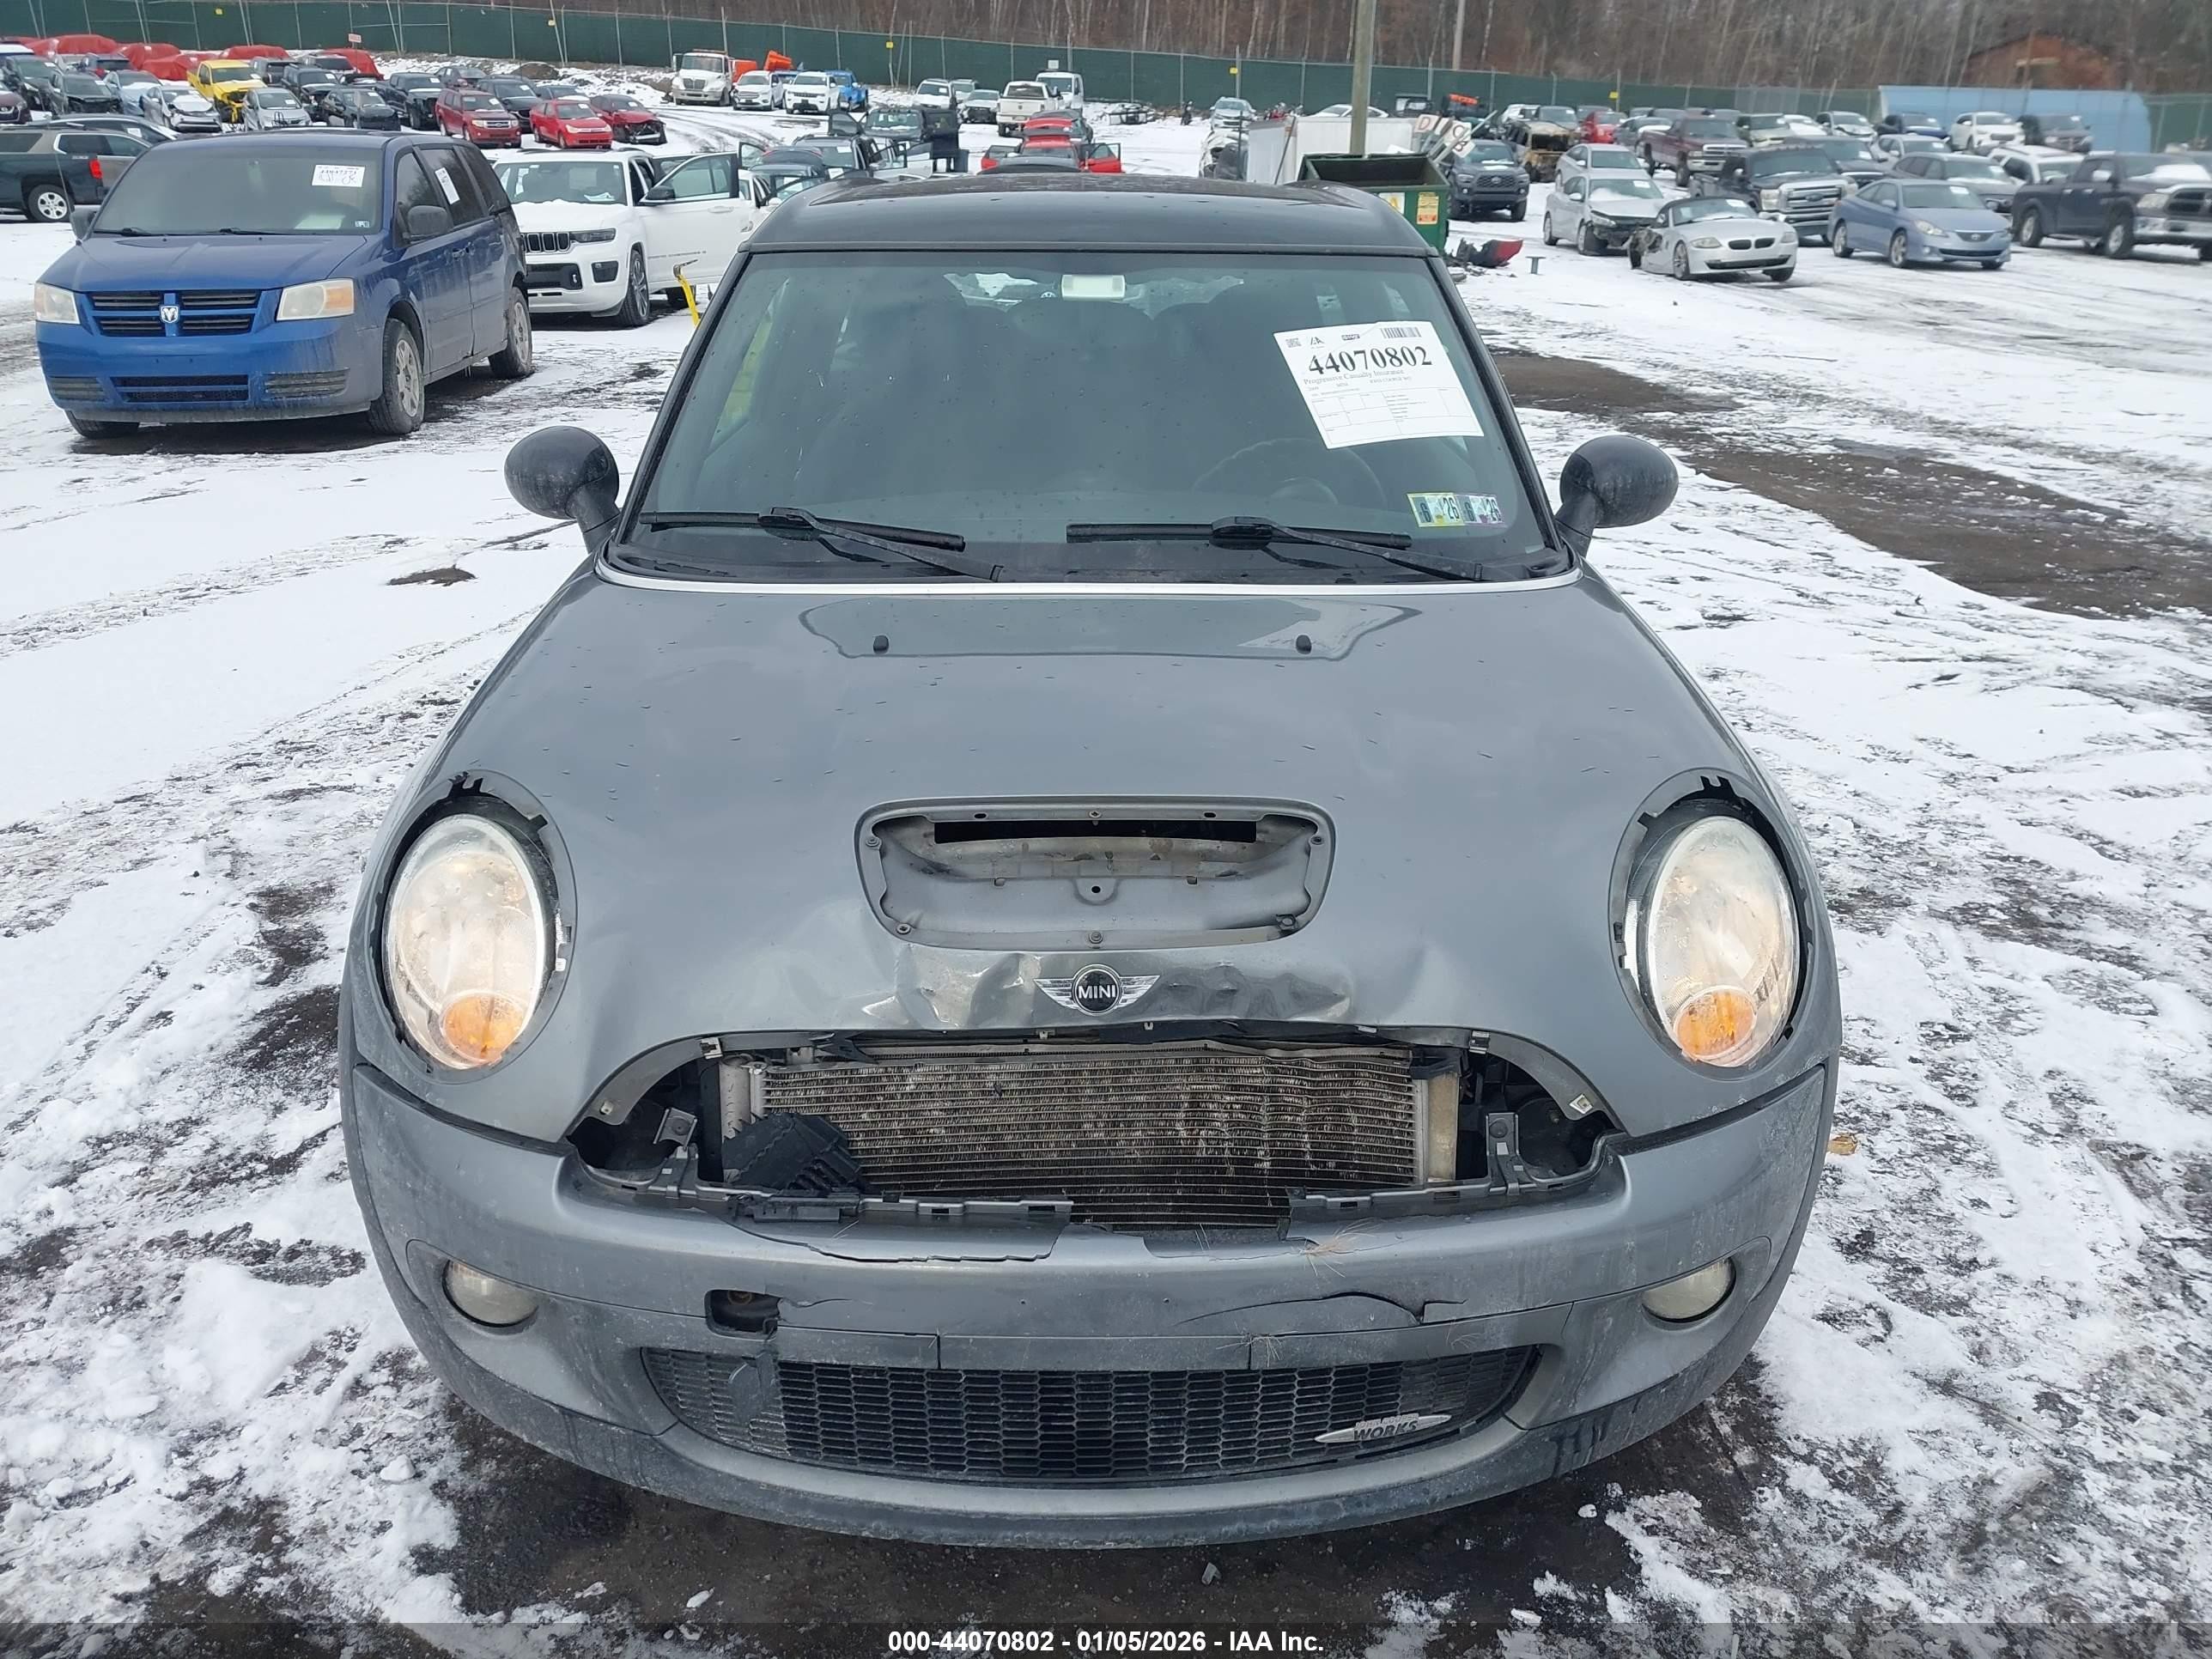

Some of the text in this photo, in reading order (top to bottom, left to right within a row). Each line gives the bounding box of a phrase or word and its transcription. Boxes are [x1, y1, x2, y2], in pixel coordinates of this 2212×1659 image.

[1309, 345, 1433, 374] 44070802
[1304, 374, 1343, 386] Progressive
[1343, 371, 1372, 380] Casualty
[1079, 986, 1116, 999] MINI
[1354, 1420, 1418, 1440] WORKS
